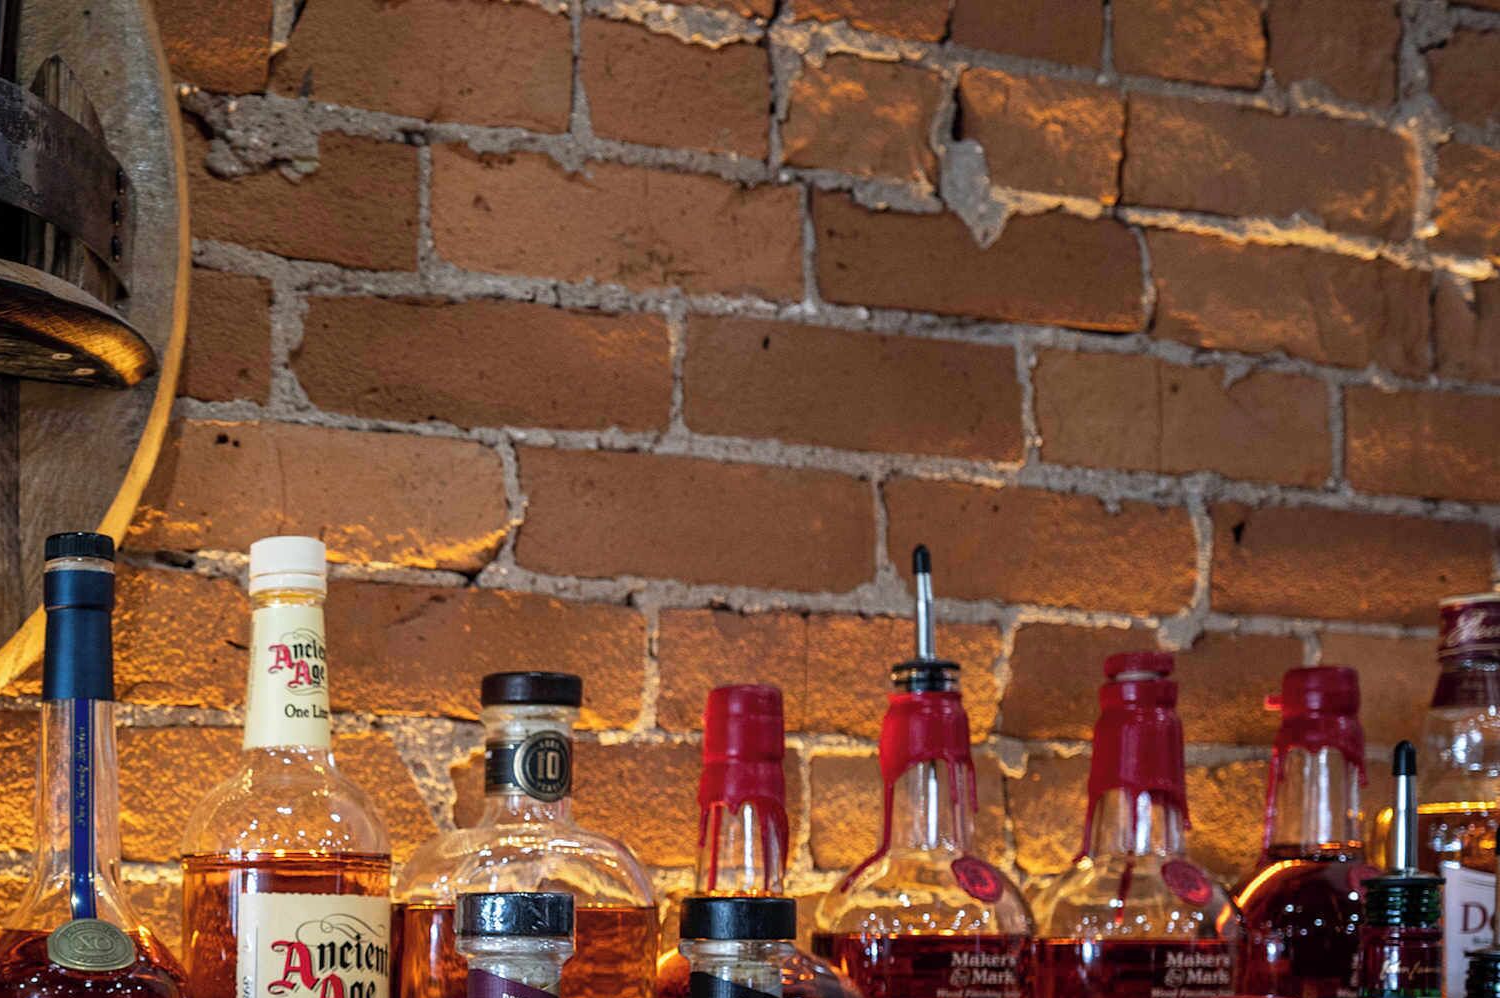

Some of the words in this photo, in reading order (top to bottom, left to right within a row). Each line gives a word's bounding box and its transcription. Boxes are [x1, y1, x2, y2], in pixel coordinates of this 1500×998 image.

[284, 703, 310, 719] One
[537, 751, 561, 780] 10
[267, 932, 389, 996] Ancient
[970, 968, 1016, 985] Mark
[1185, 967, 1230, 985] Mark
